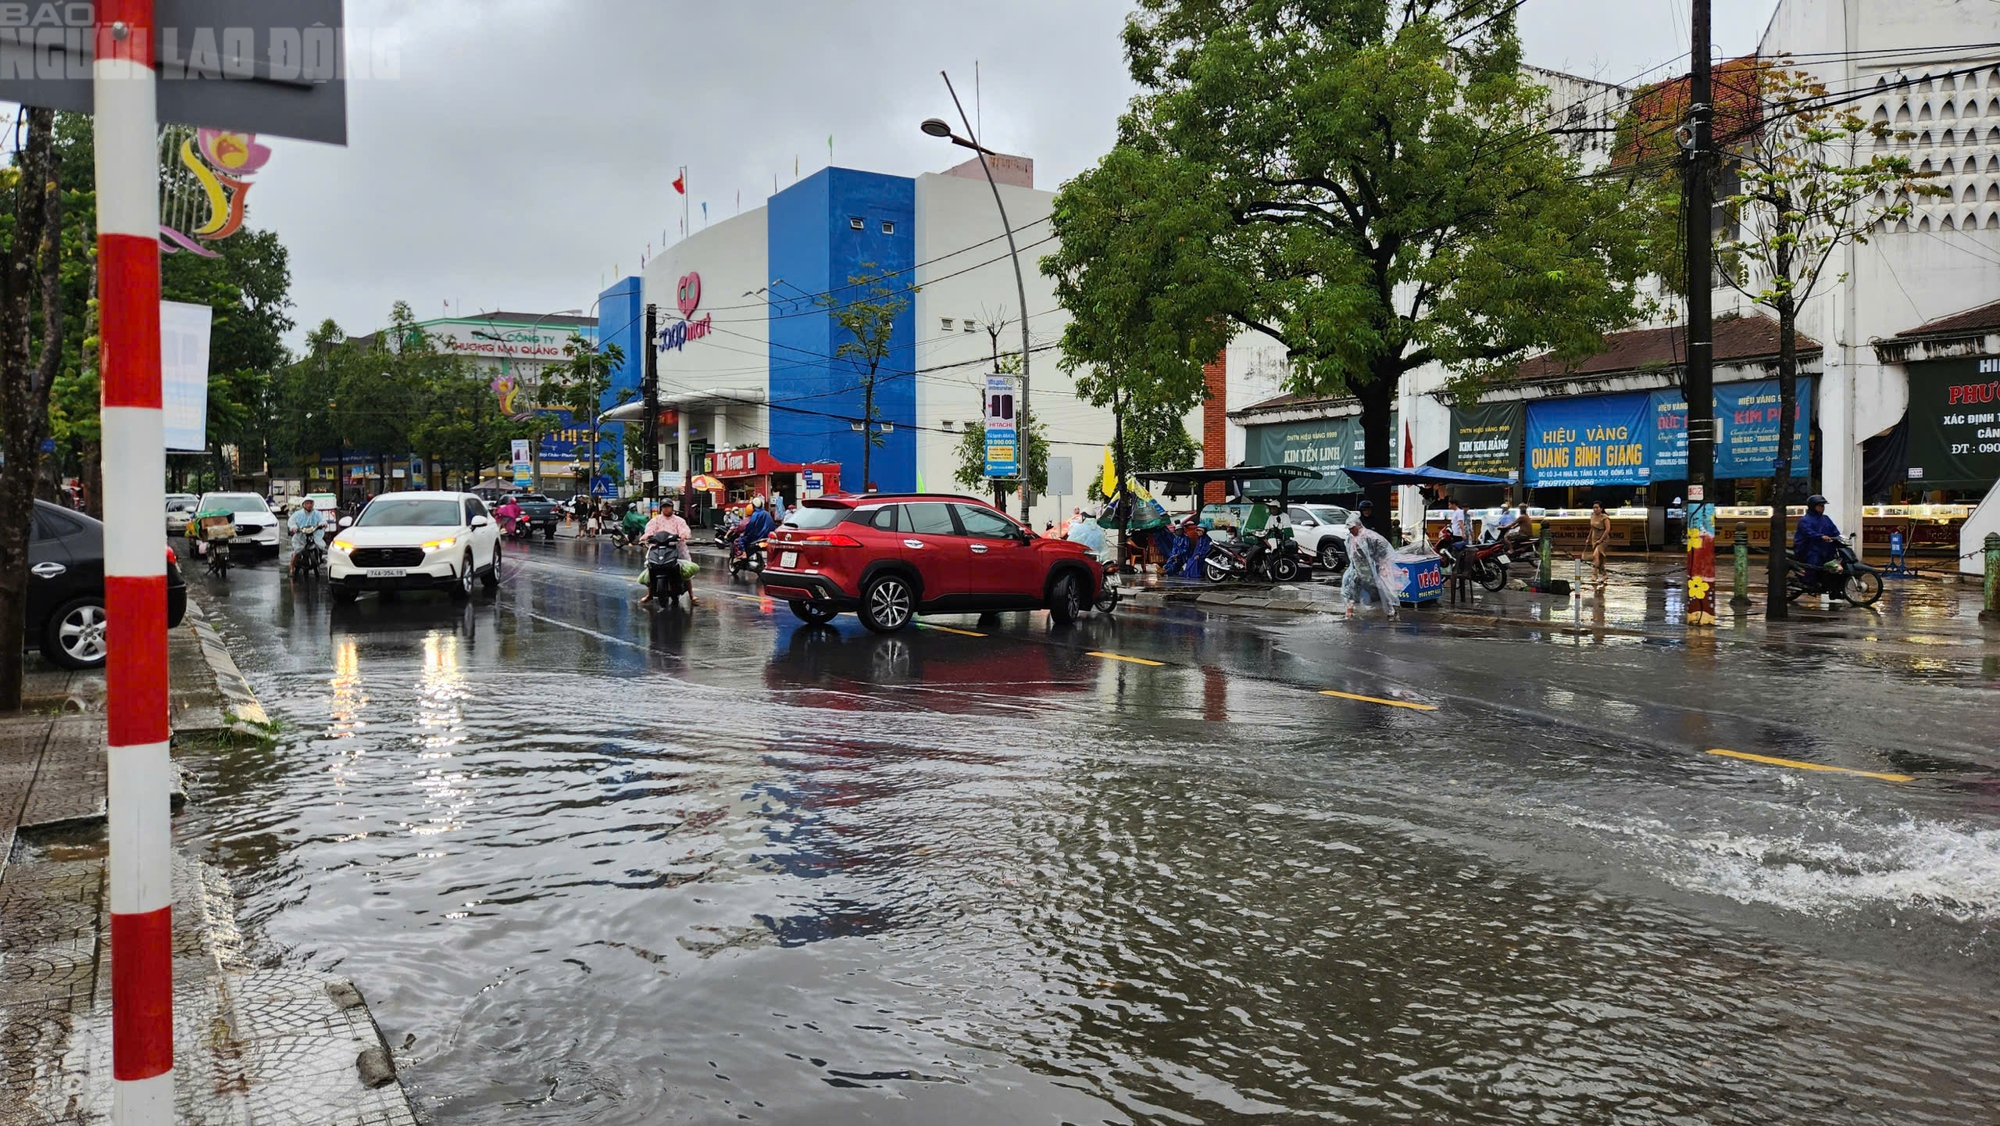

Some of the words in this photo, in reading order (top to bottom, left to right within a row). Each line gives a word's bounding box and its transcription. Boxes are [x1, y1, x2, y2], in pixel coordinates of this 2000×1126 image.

[507, 332, 540, 344] CÔNG
[544, 335, 555, 345] TY
[1756, 394, 1776, 404] VÀNG
[1948, 381, 2000, 405] PHƯ
[1734, 409, 1762, 425] KIM
[1943, 413, 1965, 425] XÁC
[1967, 413, 1994, 426] ĐỊNH
[1542, 426, 1576, 446] HIỆU
[1586, 424, 1628, 442] VÀNG
[1284, 449, 1299, 464] KIM
[1301, 442, 1320, 462] YẾN
[1320, 446, 1341, 461] LINH
[1459, 441, 1473, 452] KIM
[1473, 440, 1487, 451] KIM
[1531, 446, 1570, 470] QUANG
[1574, 442, 1601, 467] BÌNH
[1606, 443, 1643, 467] GIANG
